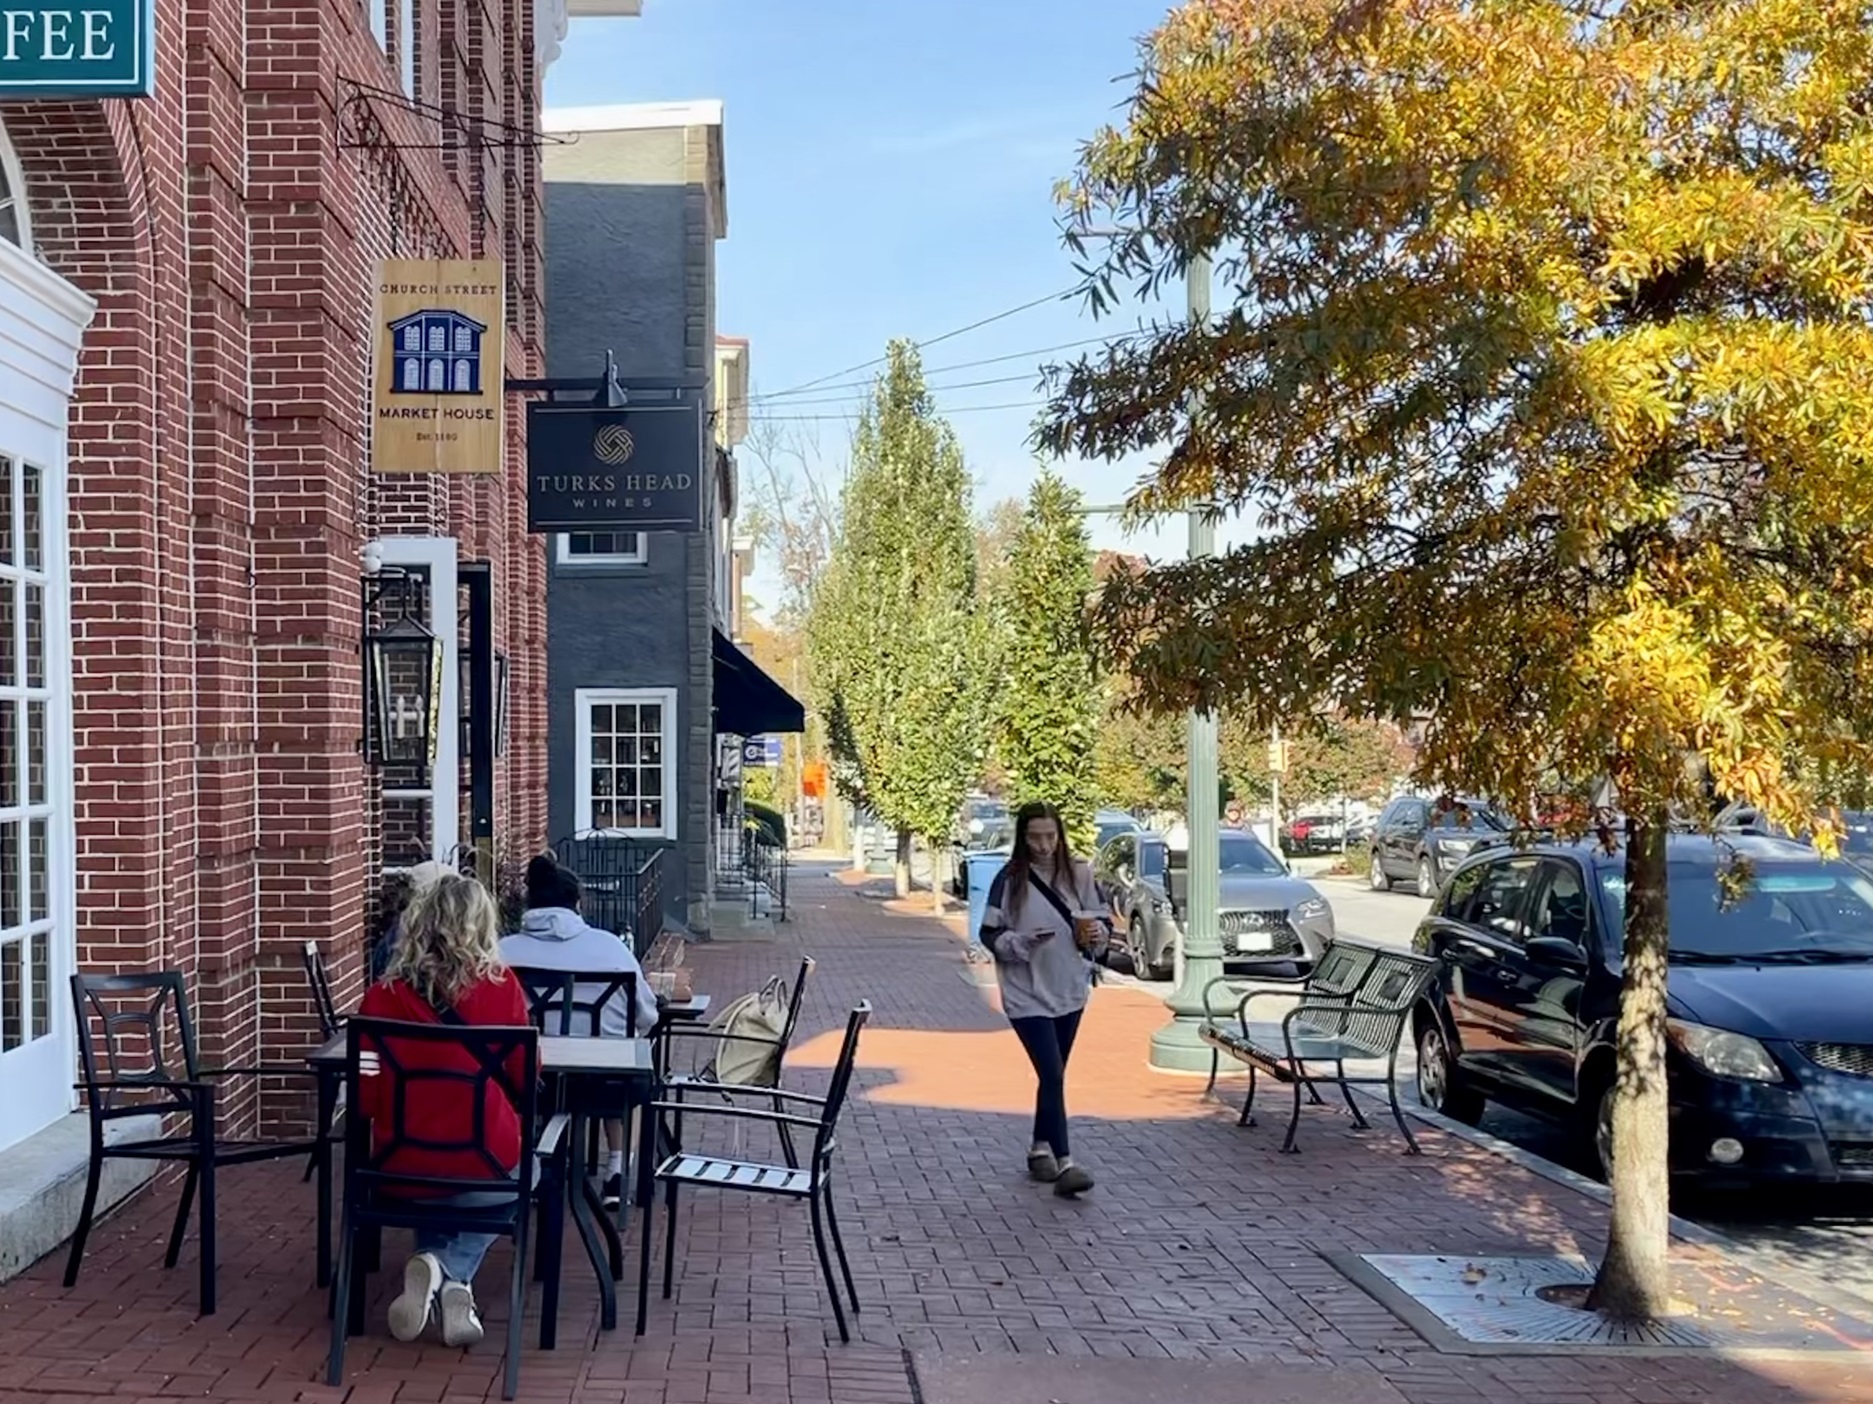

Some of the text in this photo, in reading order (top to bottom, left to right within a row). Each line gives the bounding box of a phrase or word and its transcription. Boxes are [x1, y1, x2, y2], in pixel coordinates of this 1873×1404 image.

[2, 10, 115, 60] FEE
[379, 284, 497, 295] CHURCH STREET
[379, 408, 495, 420] MARKET HOUSE
[537, 473, 692, 492] TURKS HEAD
[572, 498, 652, 508] WINES
